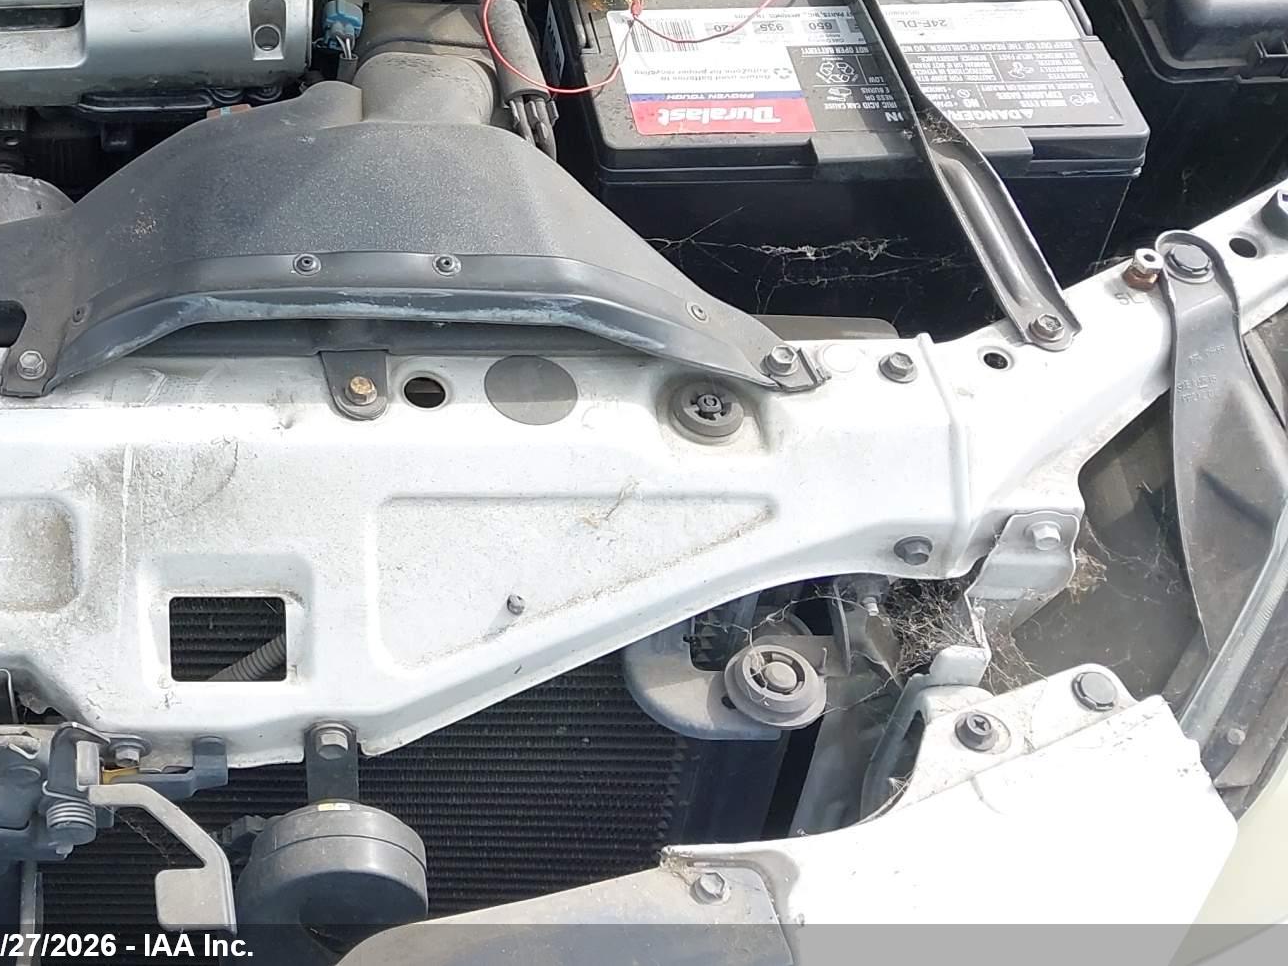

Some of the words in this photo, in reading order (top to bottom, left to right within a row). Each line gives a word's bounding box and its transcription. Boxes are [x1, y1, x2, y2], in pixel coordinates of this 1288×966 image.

[759, 23, 784, 32] 935
[808, 21, 833, 31] 650
[657, 106, 782, 127] Duralast
